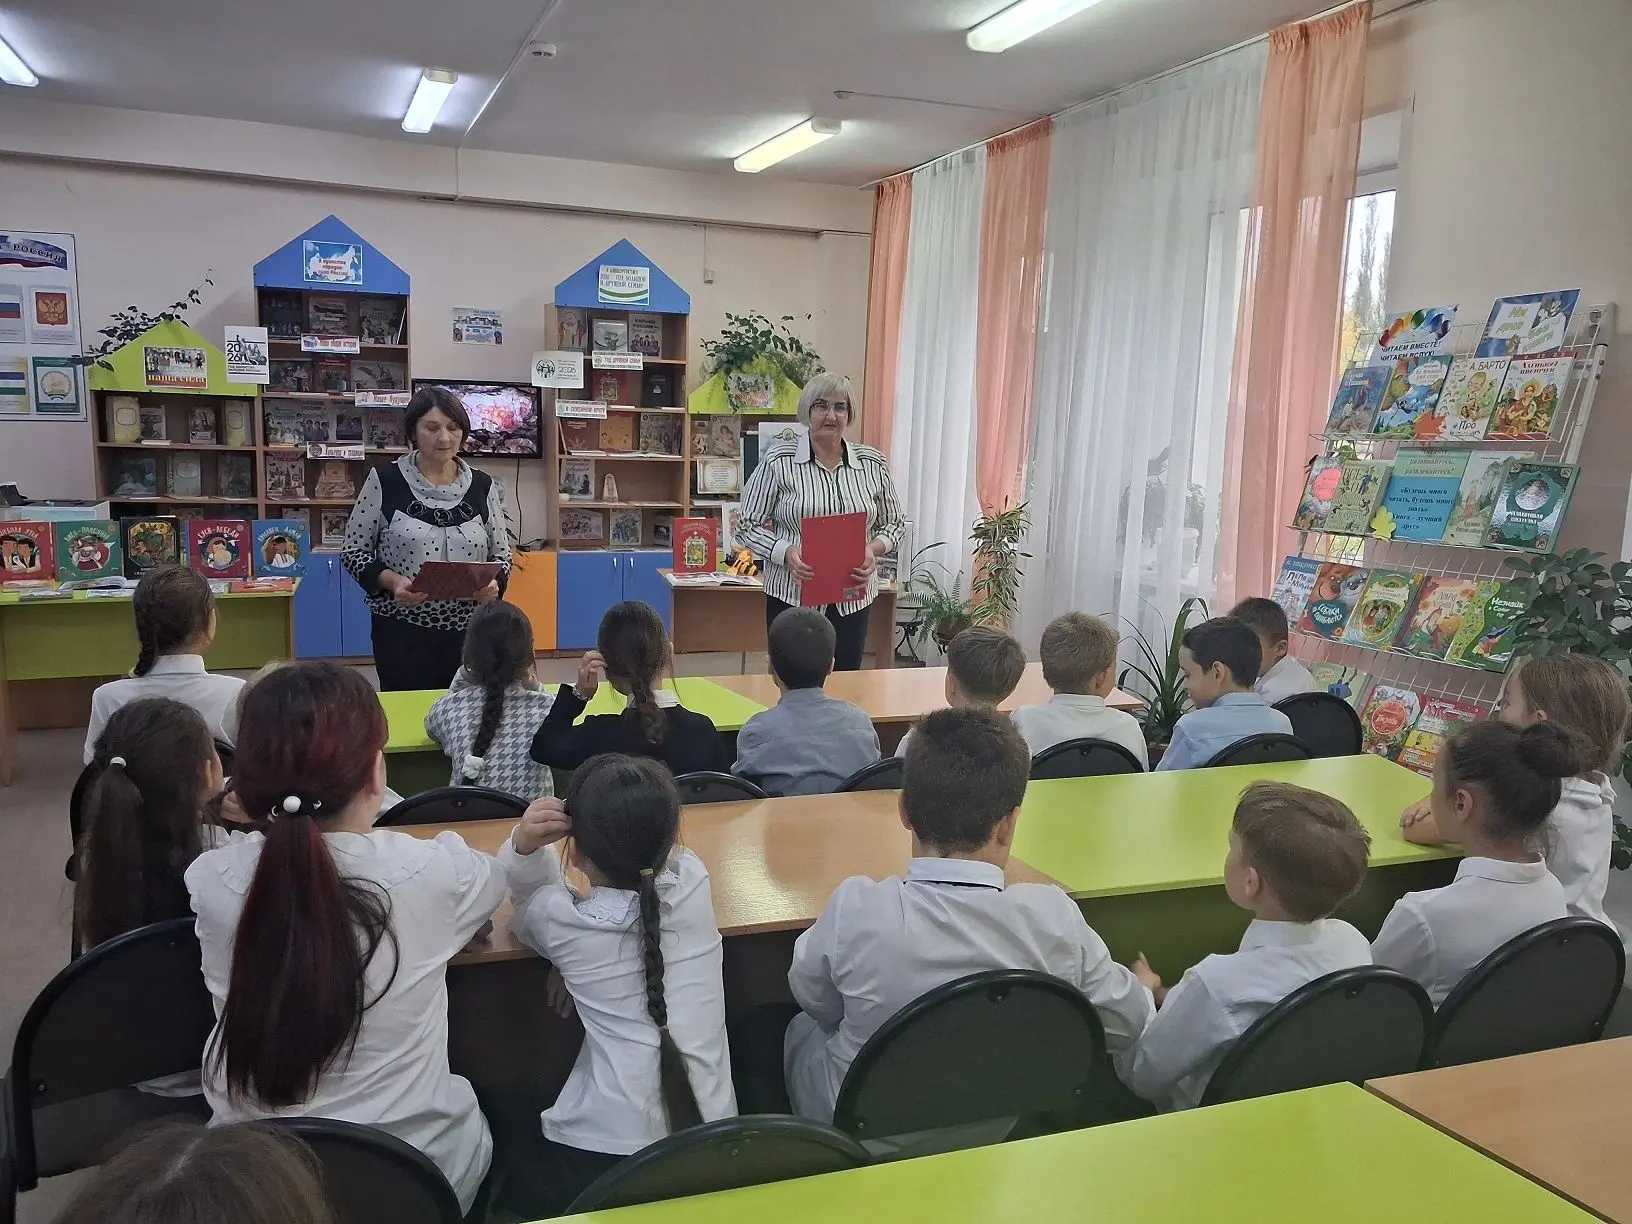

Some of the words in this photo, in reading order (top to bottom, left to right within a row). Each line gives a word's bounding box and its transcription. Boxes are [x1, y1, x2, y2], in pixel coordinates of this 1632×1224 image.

[227, 343, 240, 352] 20
[1381, 344, 1408, 353] ЧИТАЕМ
[1409, 341, 1441, 350] ВМЕСТЕ!
[227, 353, 240, 362] 26
[1478, 360, 1506, 371] БАРТО
[1458, 421, 1477, 430] Про
[1491, 597, 1526, 608] Незнайк
